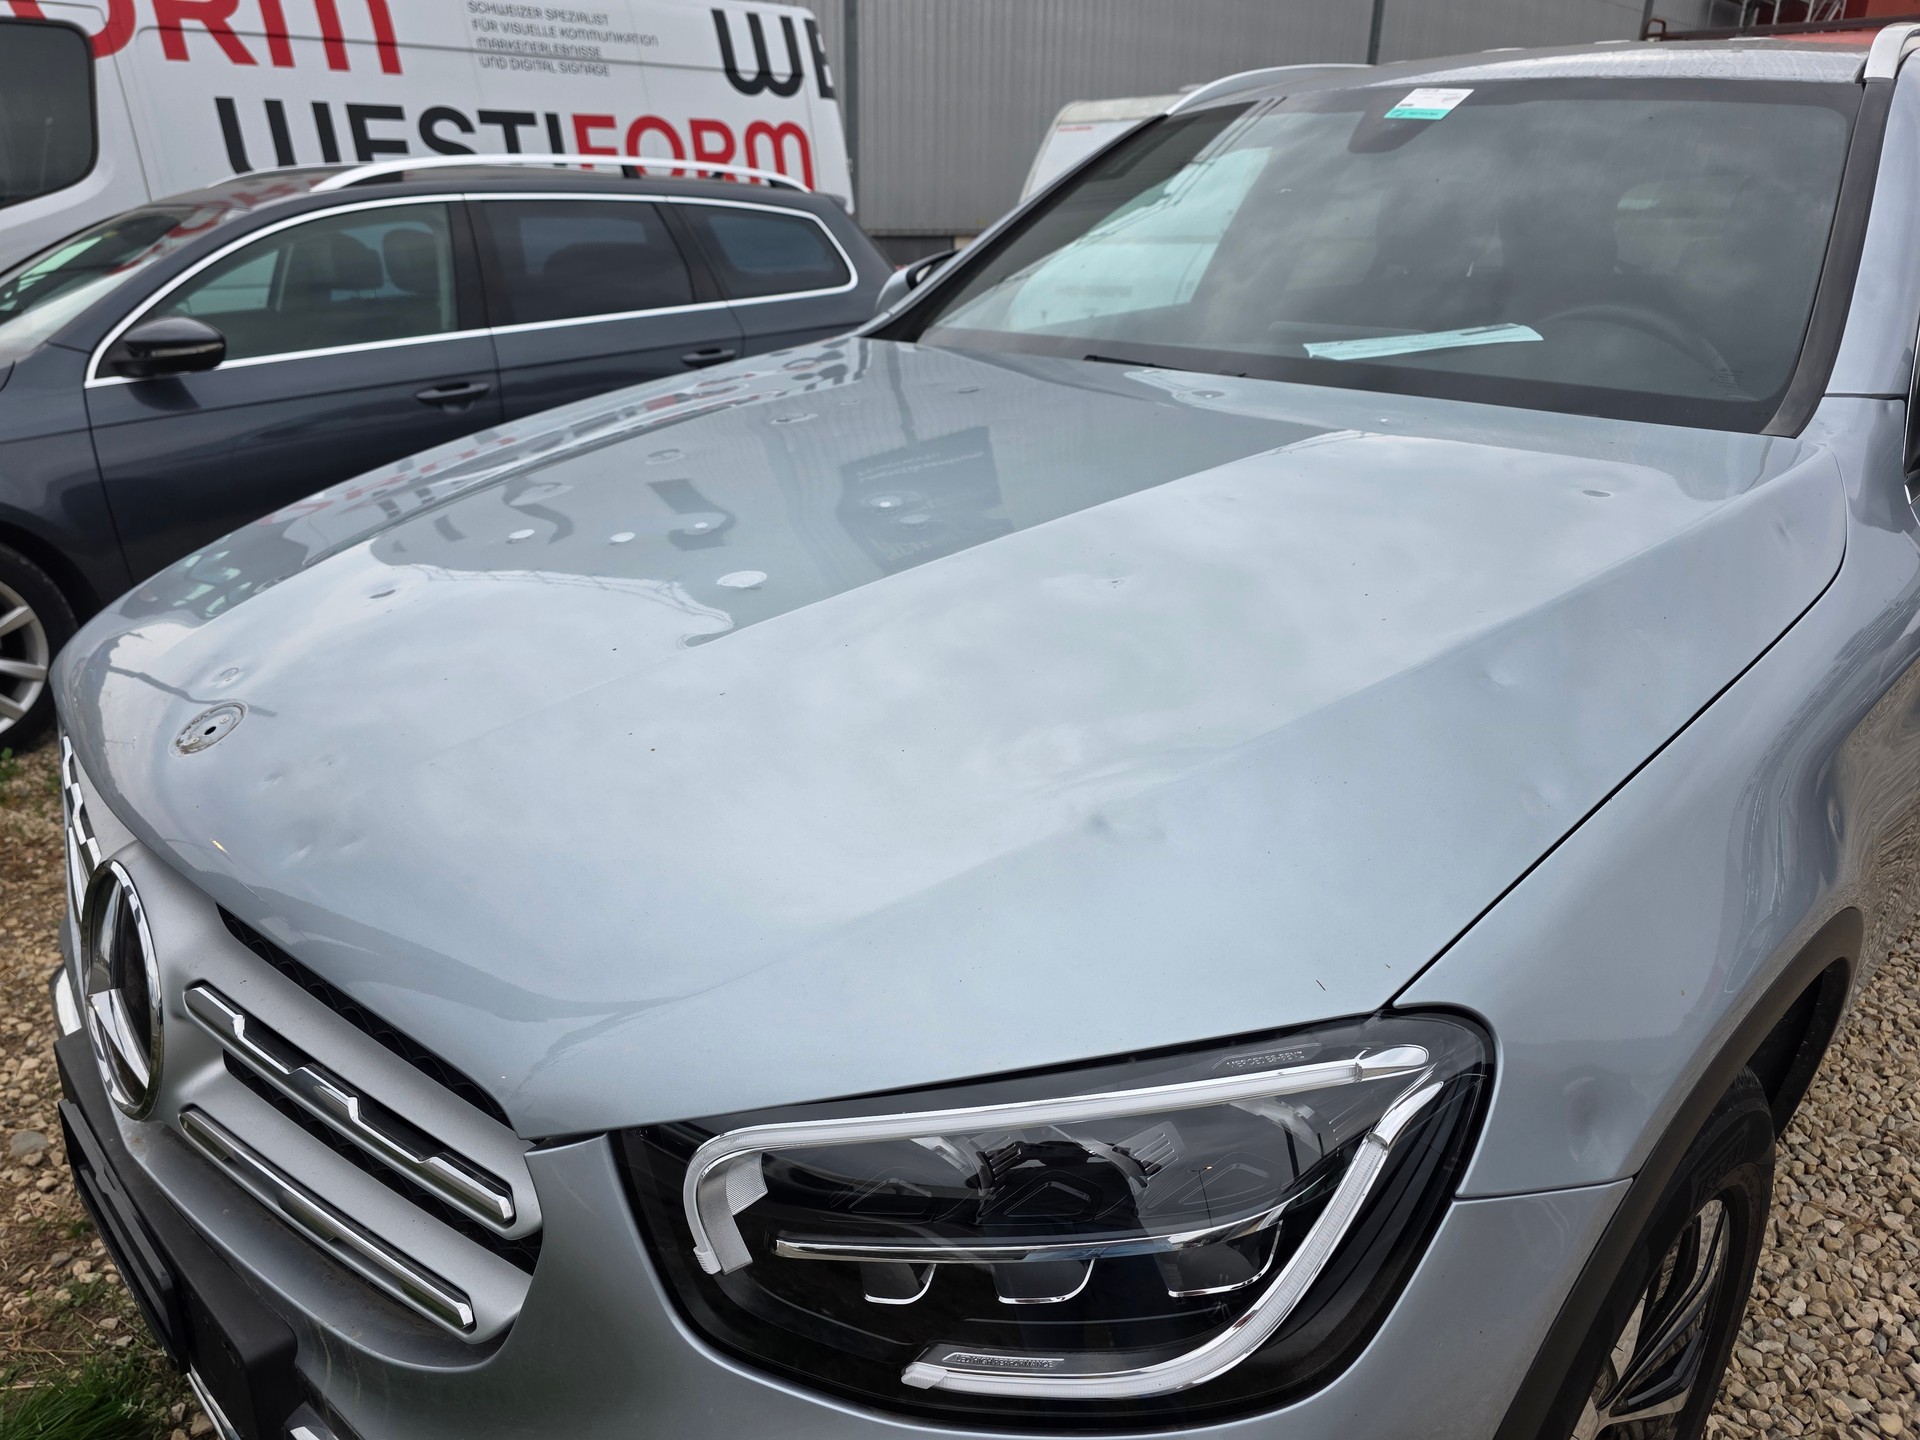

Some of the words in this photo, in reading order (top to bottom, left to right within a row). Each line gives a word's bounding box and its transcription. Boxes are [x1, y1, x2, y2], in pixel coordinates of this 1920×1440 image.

[467, 1, 543, 18] SCHWEIZER
[544, 8, 610, 25] SPEZIALIST
[472, 17, 499, 32] FÜR
[500, 21, 558, 38] VISUELLE
[509, 57, 557, 74] DIGITAL
[559, 61, 611, 77] SIGNAGE
